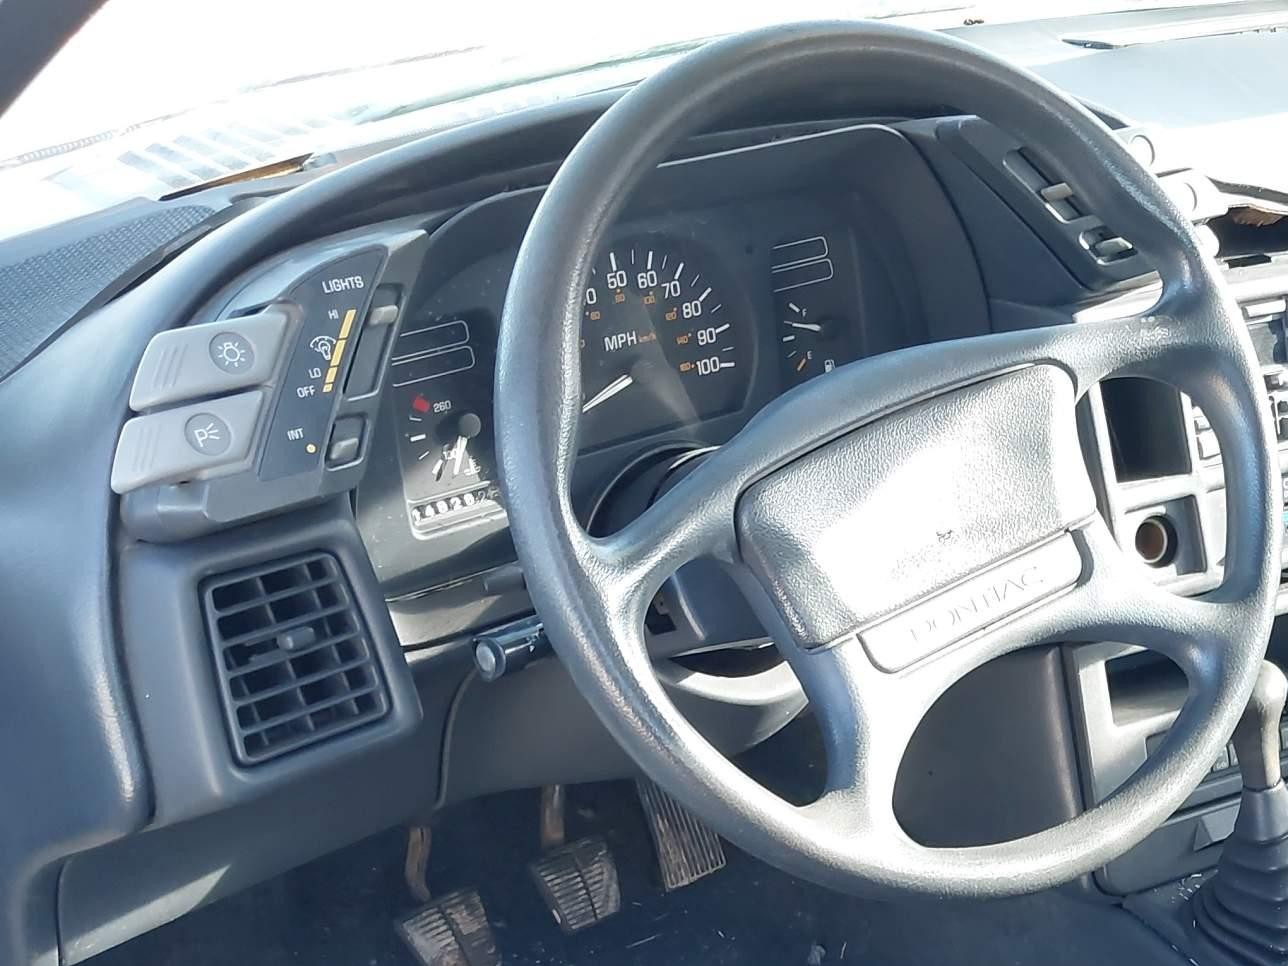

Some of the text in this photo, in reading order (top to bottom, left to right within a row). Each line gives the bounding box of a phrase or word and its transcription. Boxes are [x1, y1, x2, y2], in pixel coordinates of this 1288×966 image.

[322, 275, 365, 295] LIGHTS
[606, 270, 628, 289] 50
[637, 270, 658, 289] 60
[583, 287, 597, 305] 0
[661, 280, 681, 299] 70
[328, 309, 339, 320] HI
[682, 300, 702, 319] 80
[604, 330, 637, 352] MPH
[697, 327, 717, 346] 90
[807, 350, 813, 360] E
[308, 367, 322, 379] LO
[696, 356, 720, 376] 100
[296, 385, 316, 399] OFF
[433, 400, 452, 413] 260
[287, 427, 304, 441] INT
